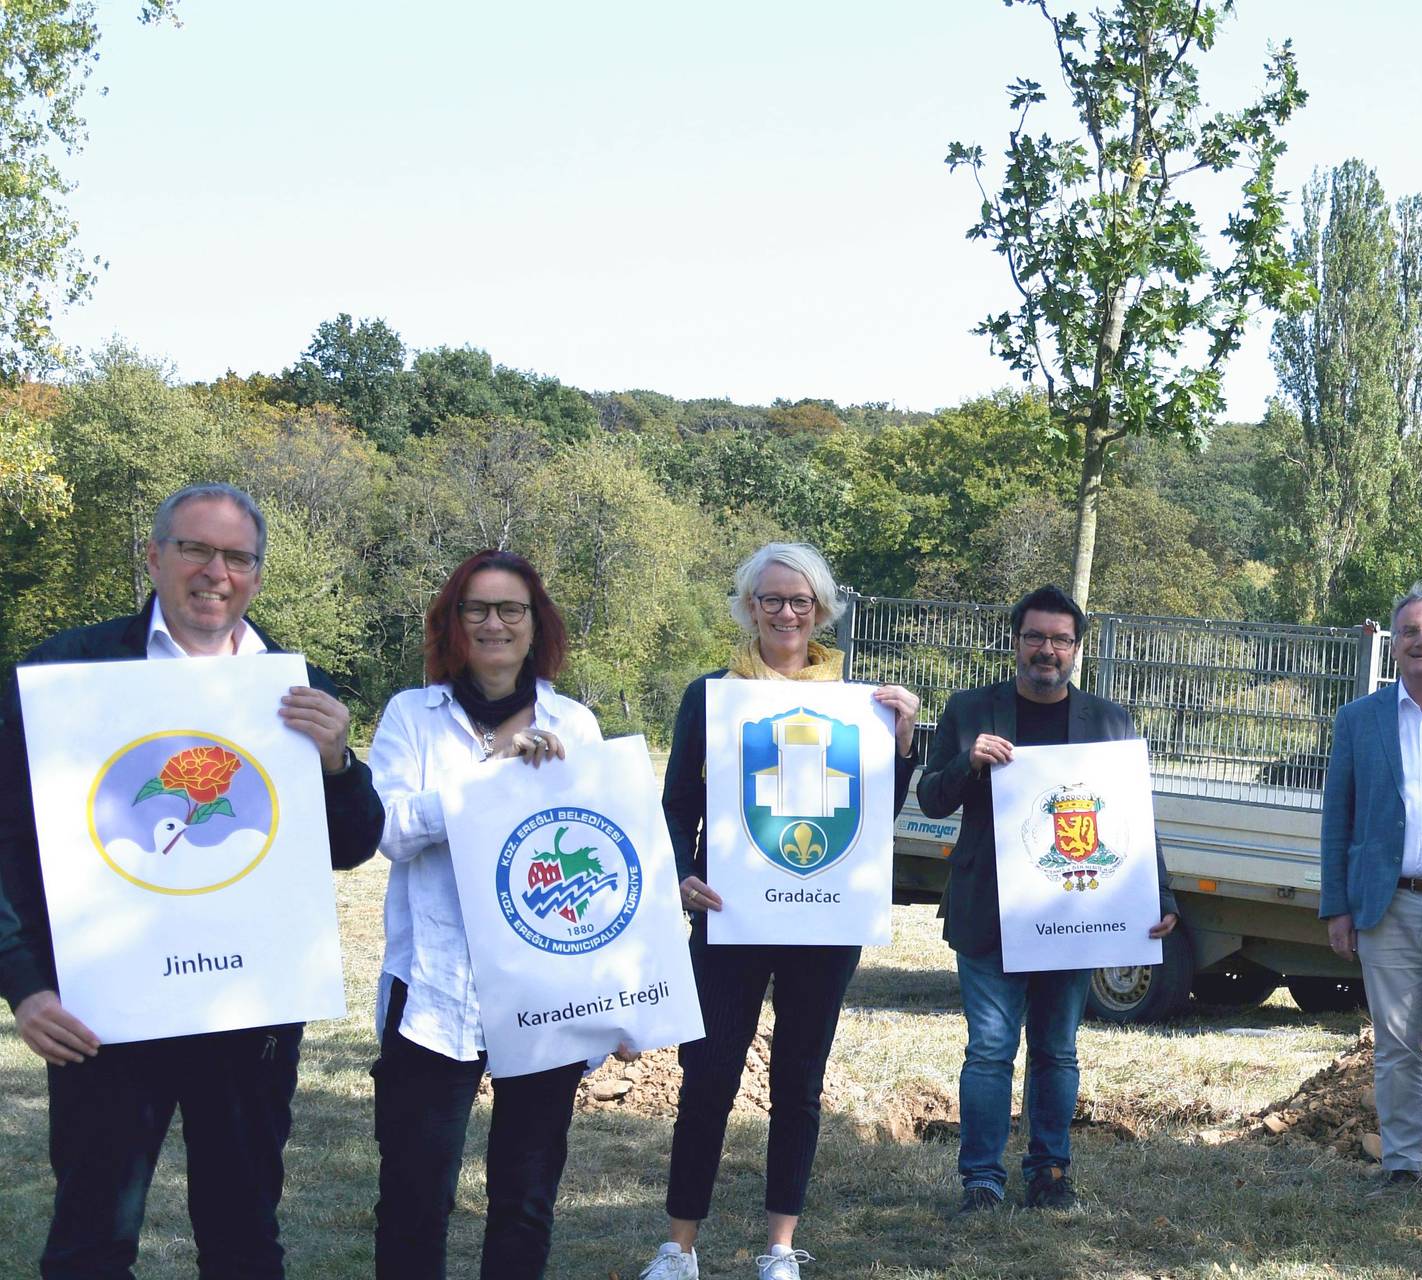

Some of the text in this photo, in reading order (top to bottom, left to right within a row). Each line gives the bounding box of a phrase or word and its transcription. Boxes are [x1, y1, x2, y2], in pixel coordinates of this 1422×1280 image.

[501, 811, 625, 867] KDZ. EREĞLİ BELEDİYESİ
[765, 888, 841, 904] Gradačac
[513, 920, 550, 949] EREĞLİ
[552, 917, 626, 953] MUNICIPALITY
[623, 865, 639, 915] TÜRKİYE
[567, 923, 594, 937] 1880
[1035, 921, 1127, 936] Valenciennes
[163, 953, 243, 977] Jinhua
[517, 981, 670, 1028] Karadeniz Ereğli
